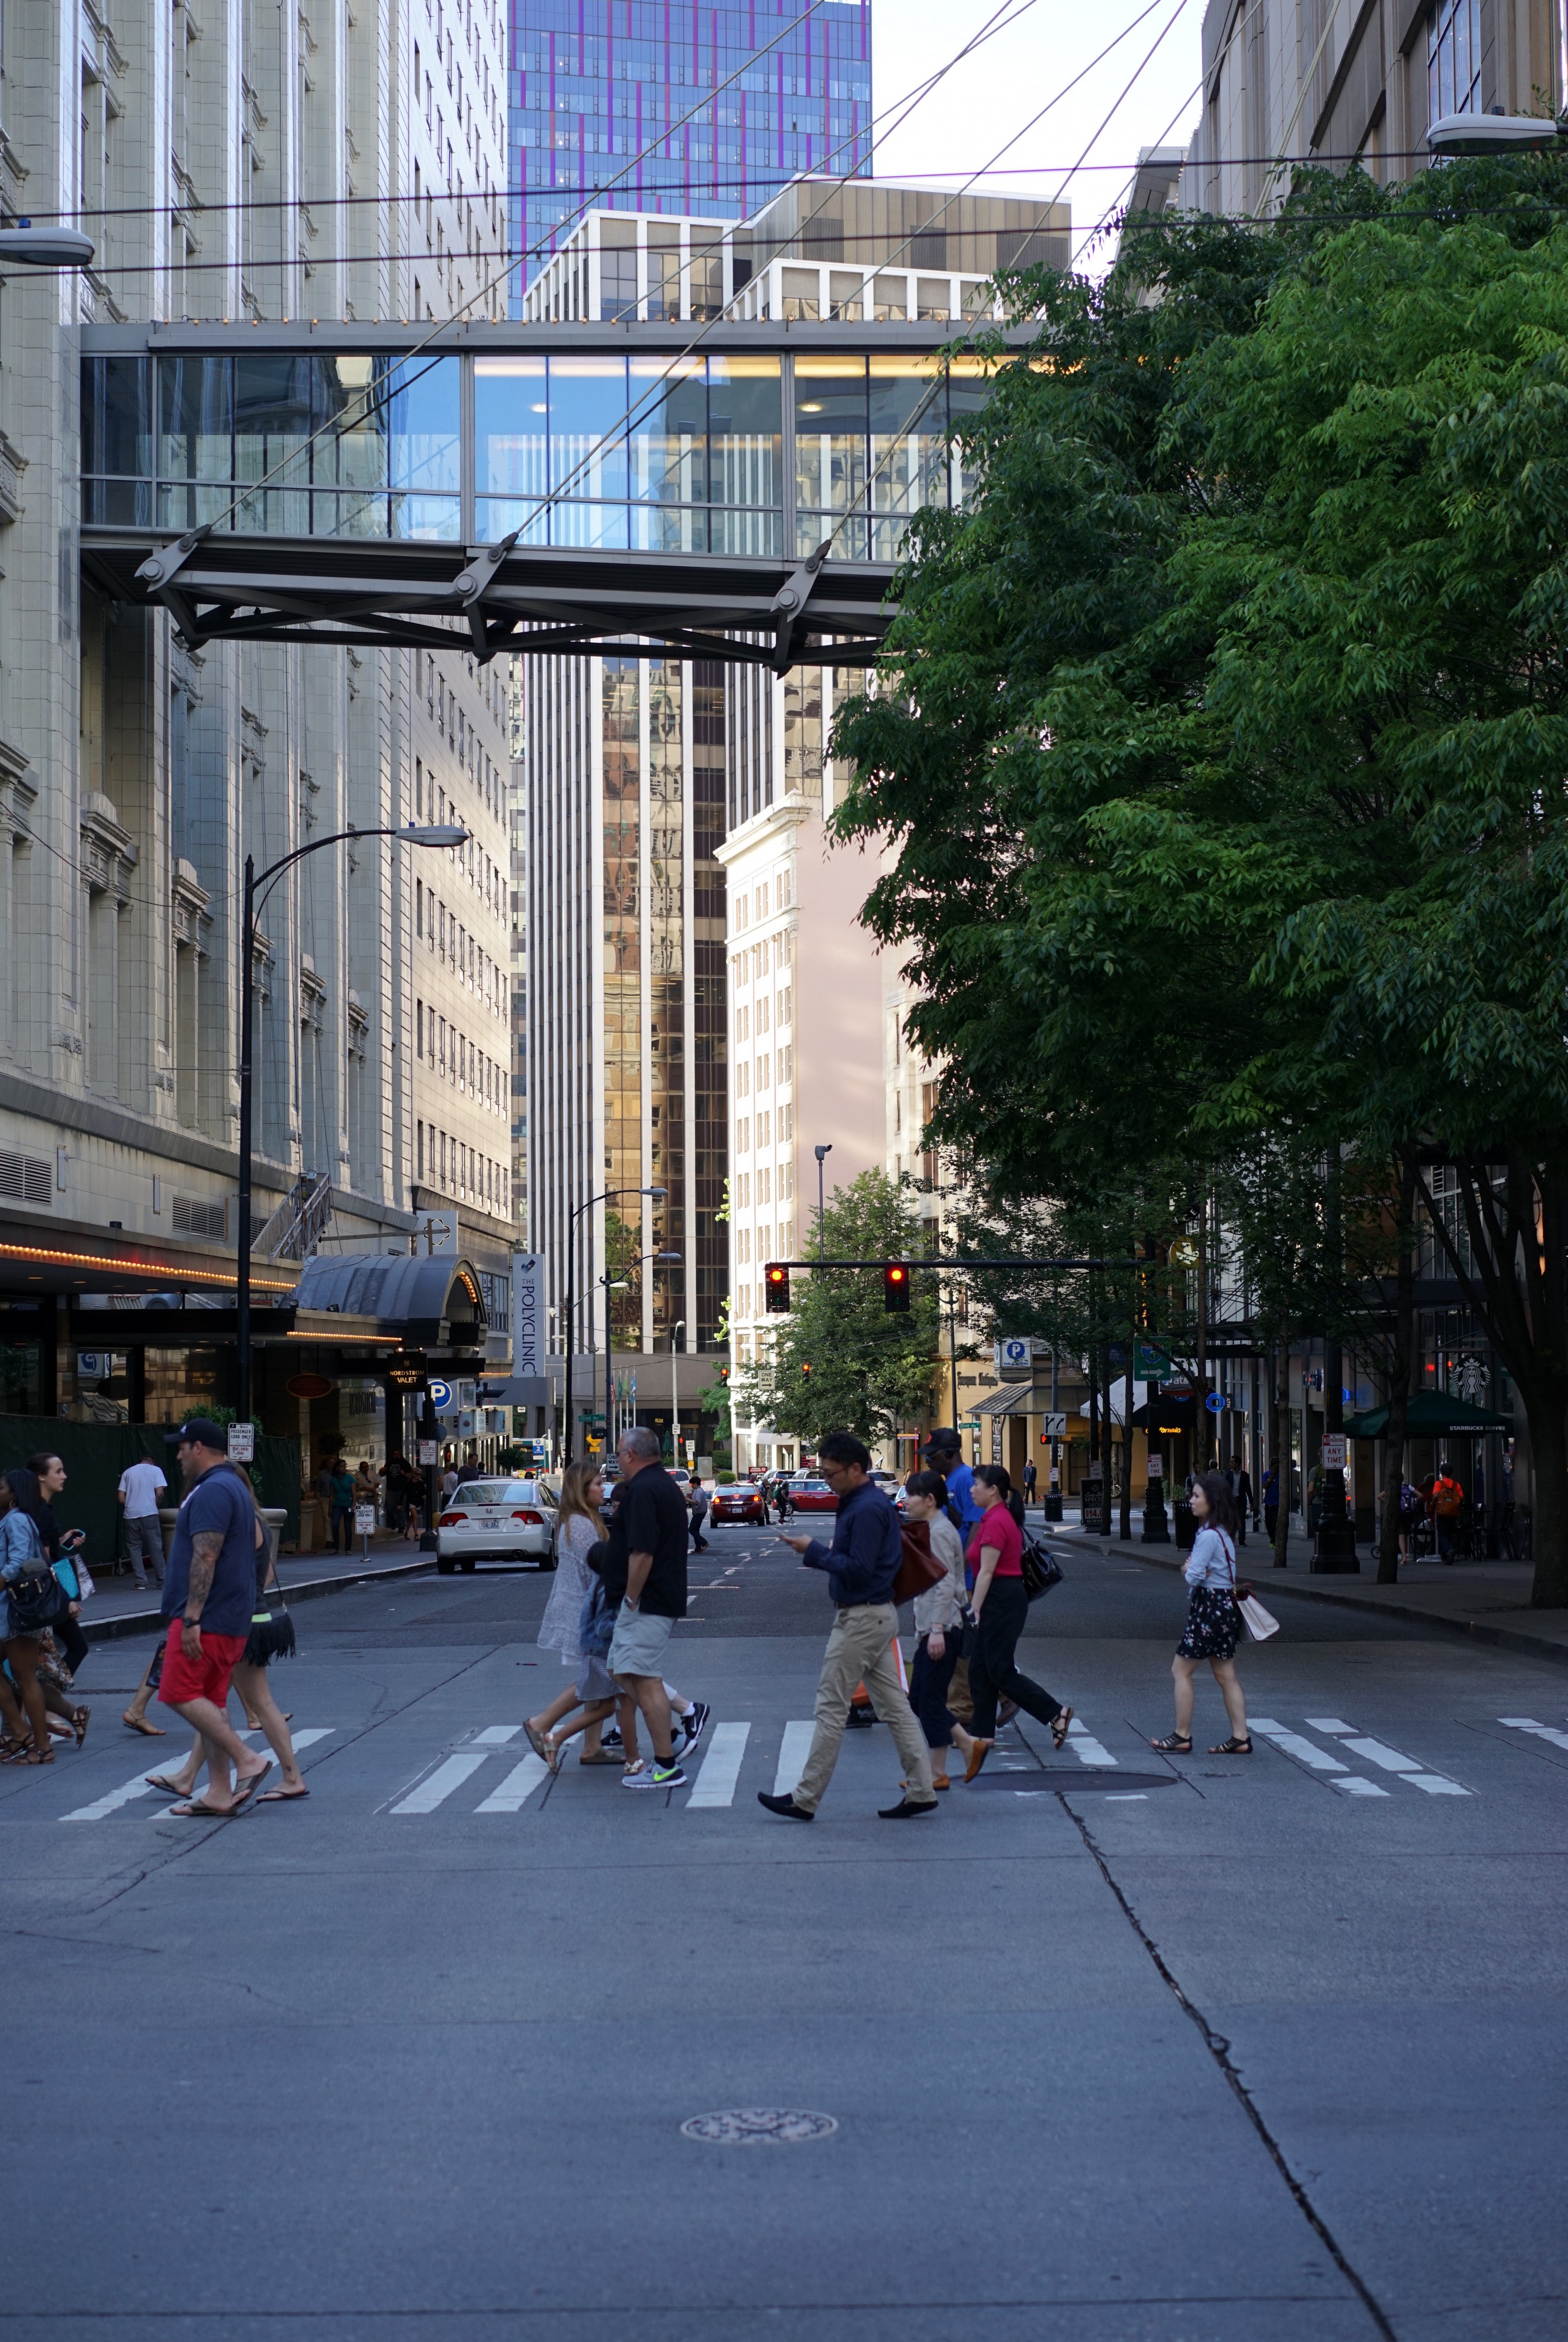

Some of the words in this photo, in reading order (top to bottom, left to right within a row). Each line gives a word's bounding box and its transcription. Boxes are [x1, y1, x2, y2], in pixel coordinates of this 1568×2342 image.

[522, 1286, 535, 1372] POLYCLINIC
[1012, 1344, 1021, 1357] P
[957, 1371, 977, 1389] European
[1173, 1375, 1189, 1385] at&
[430, 1385, 446, 1403] P
[350, 1391, 376, 1416] NORDSTROM
